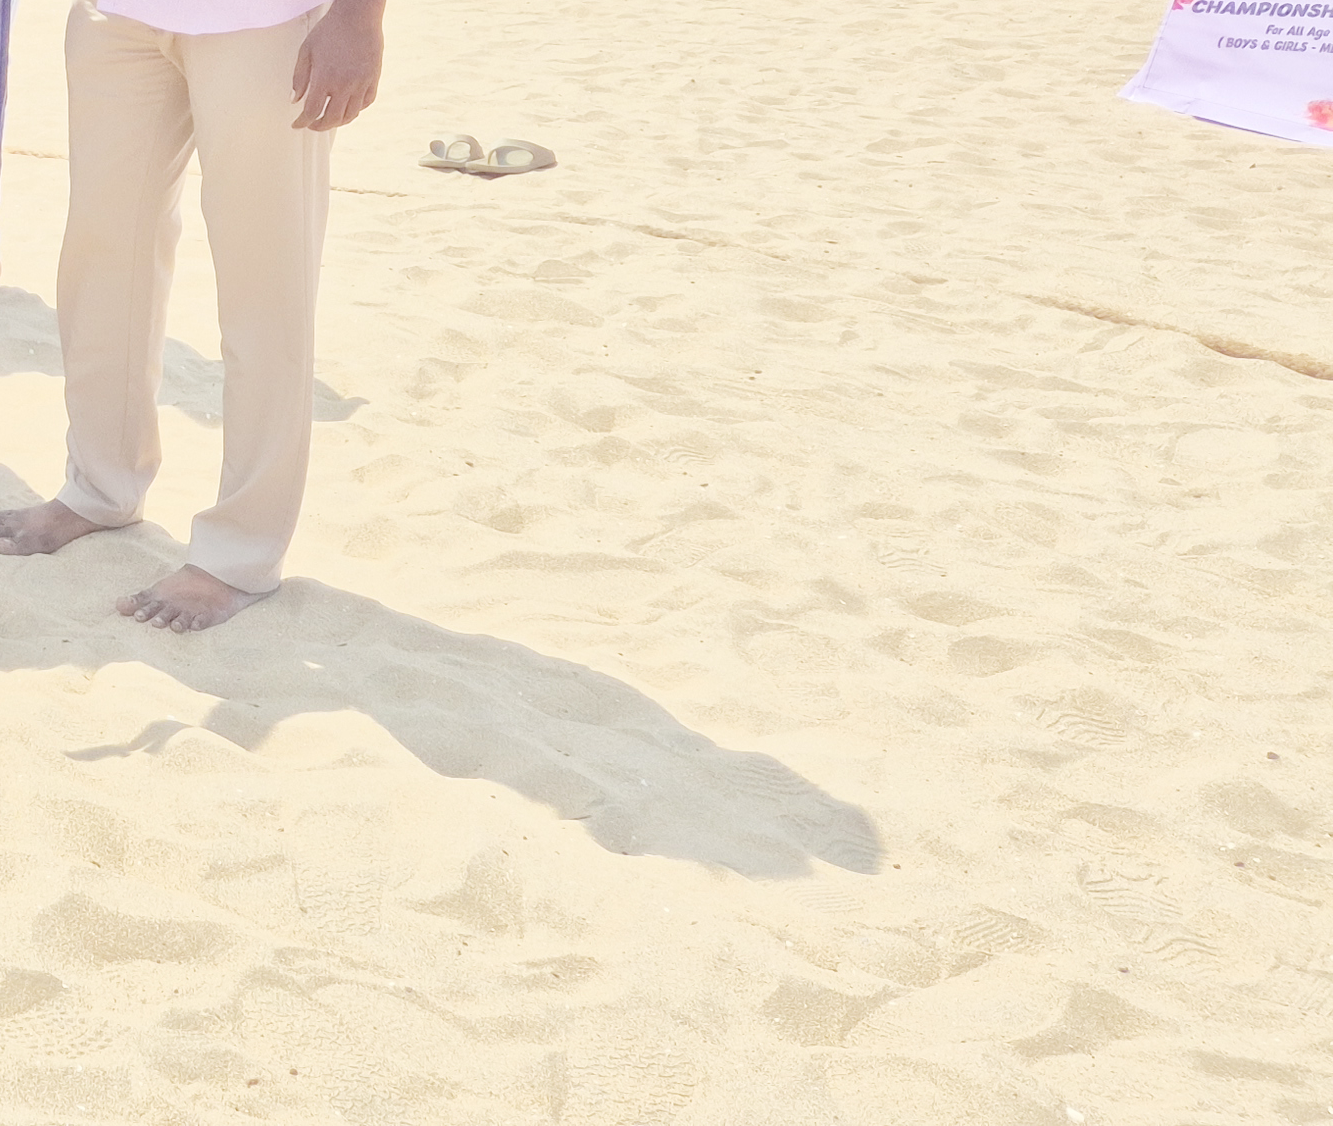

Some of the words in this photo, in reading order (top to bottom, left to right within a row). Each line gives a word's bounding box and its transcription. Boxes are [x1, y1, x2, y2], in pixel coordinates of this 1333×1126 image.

[1191, 0, 1333, 18] CHAMPIONSH
[1265, 24, 1285, 35] For
[1286, 25, 1305, 36] All
[1273, 40, 1309, 52] GIRLS
